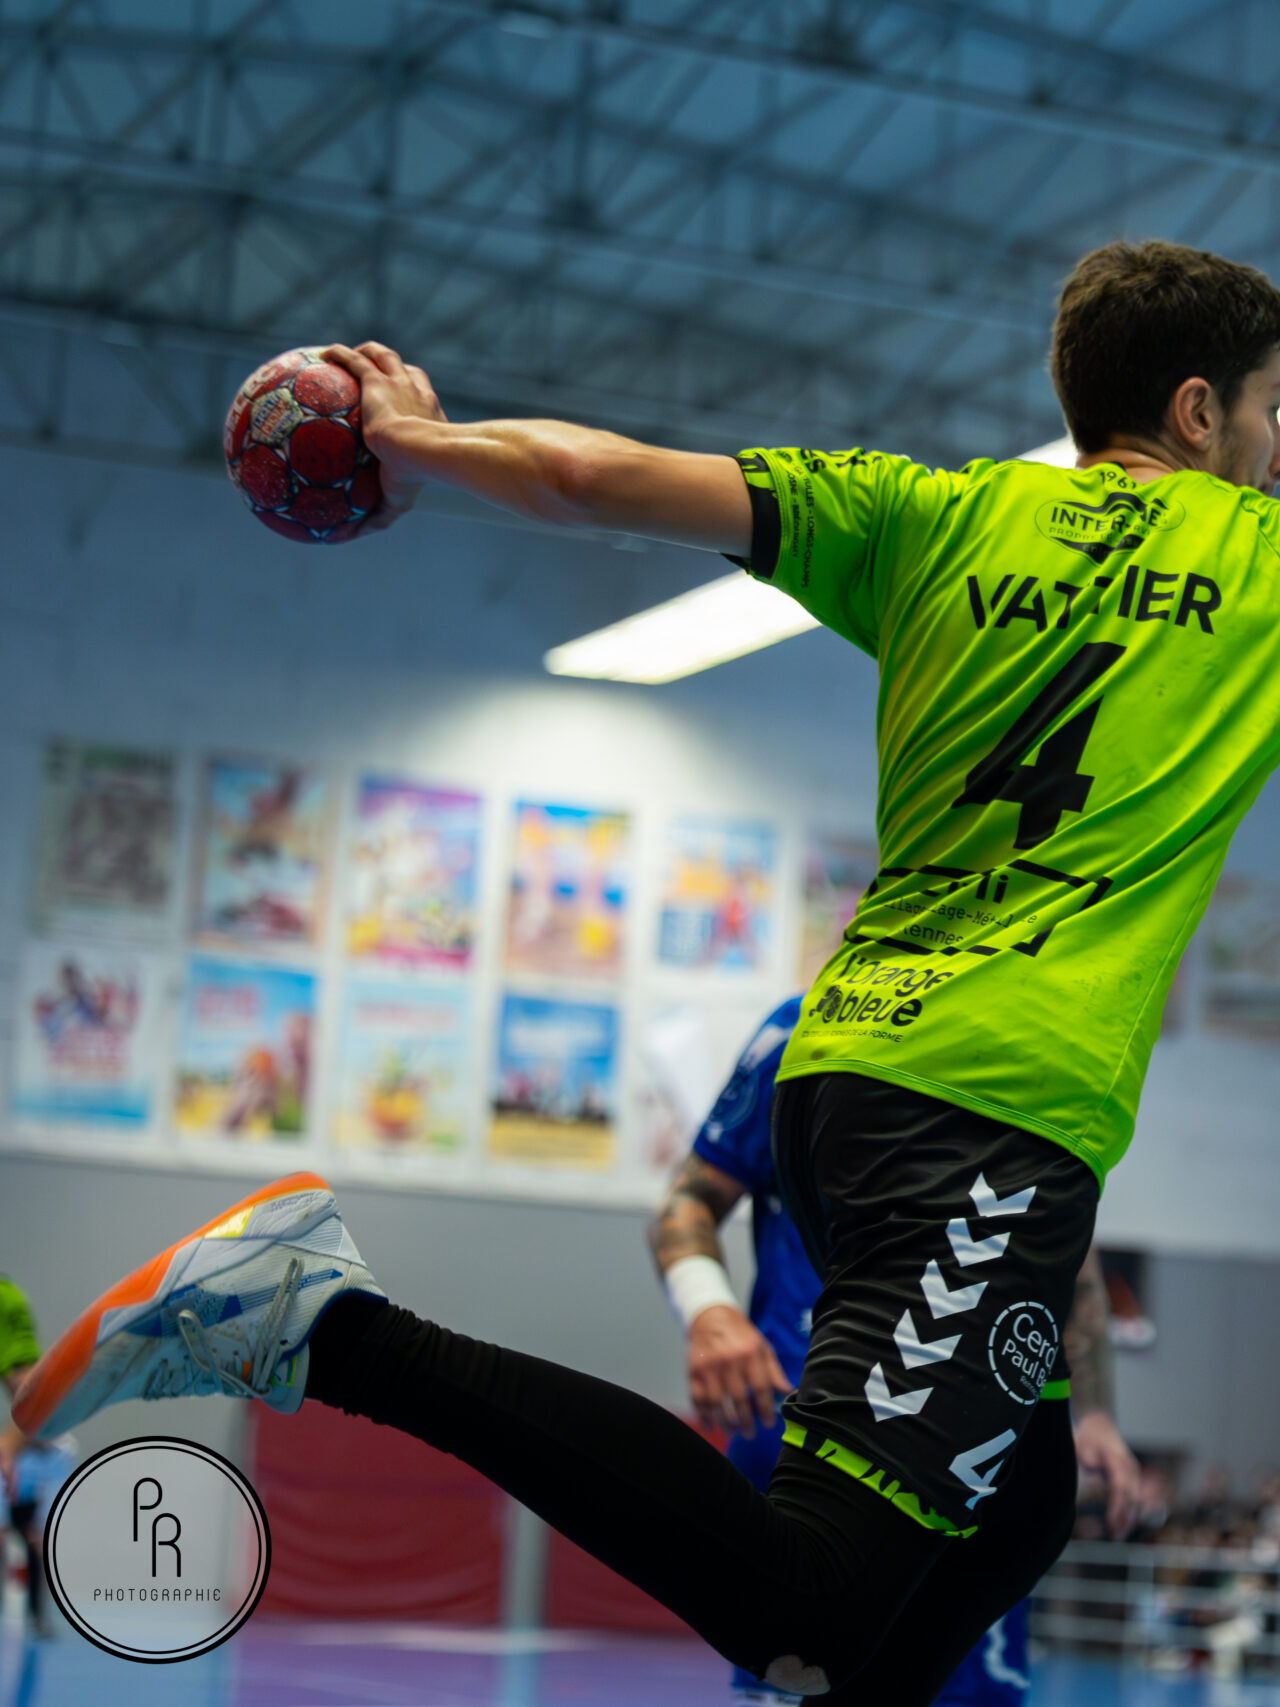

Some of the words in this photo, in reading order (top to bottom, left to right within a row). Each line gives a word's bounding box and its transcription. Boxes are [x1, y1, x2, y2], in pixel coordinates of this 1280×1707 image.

[967, 565, 1222, 634] VATTIER
[951, 642, 1127, 850] 4
[837, 989, 922, 1026] bleue
[1001, 1339, 1039, 1378] Paul
[949, 1428, 1016, 1510] 4
